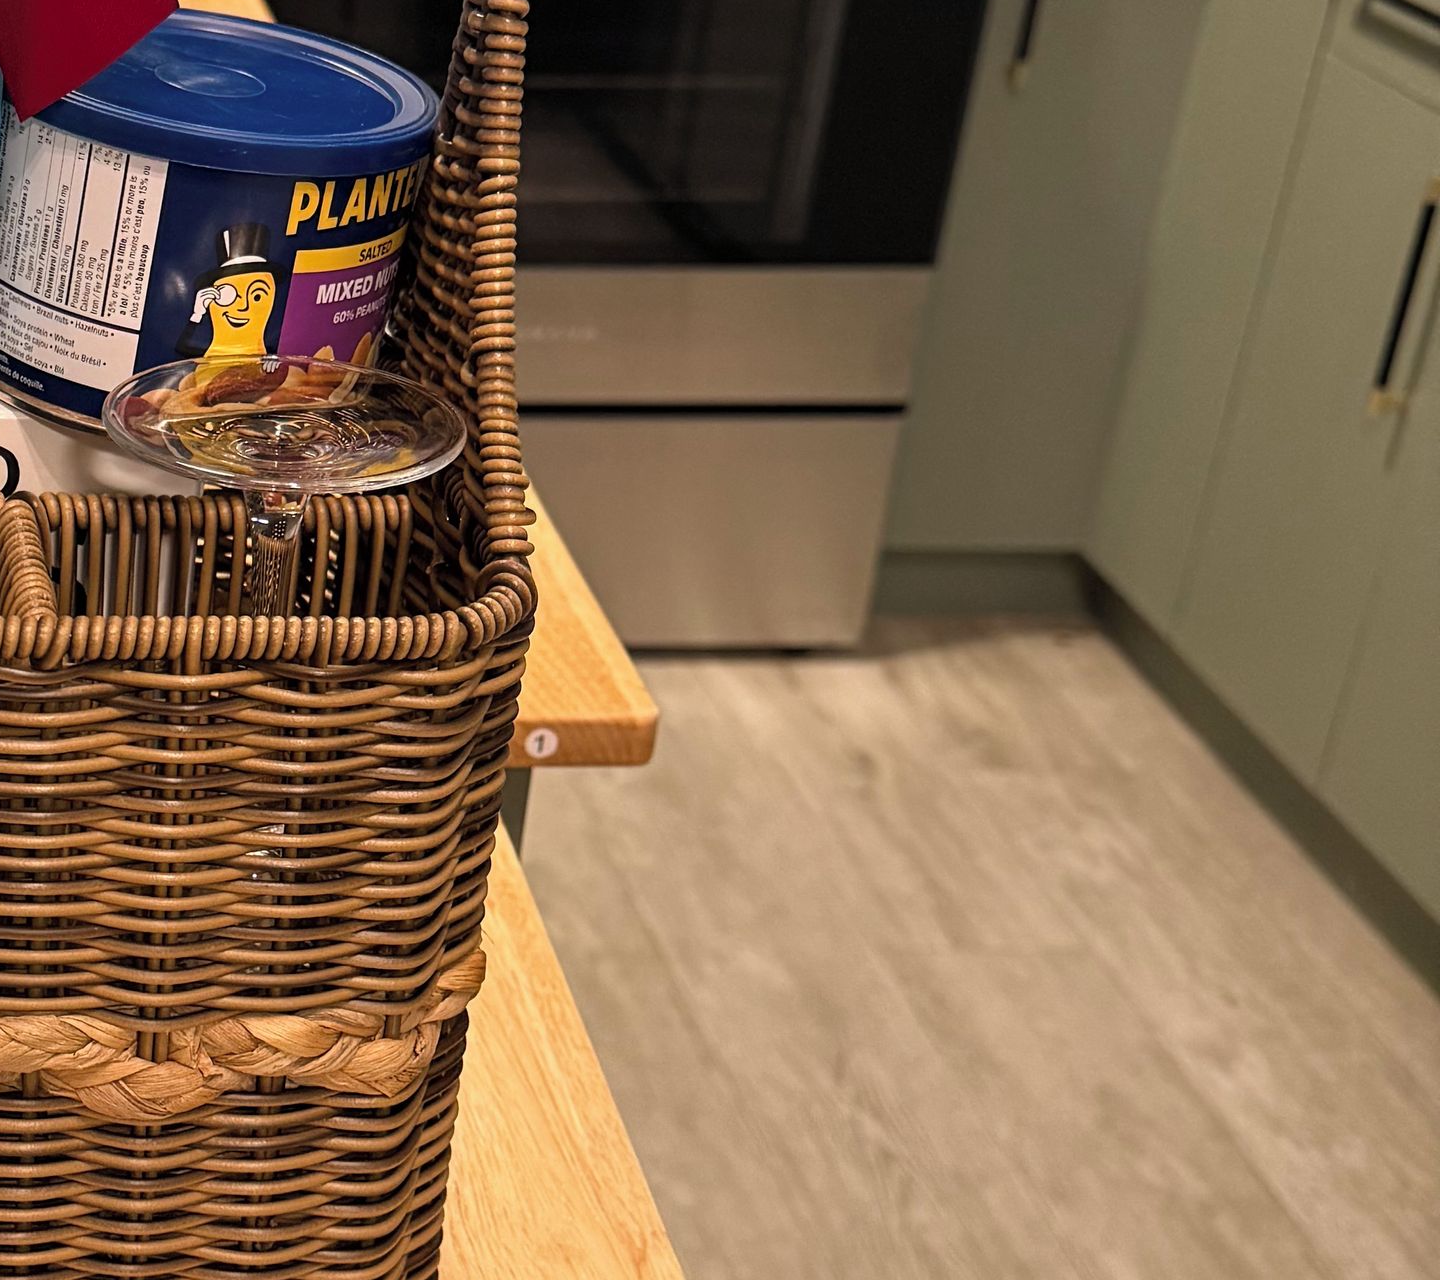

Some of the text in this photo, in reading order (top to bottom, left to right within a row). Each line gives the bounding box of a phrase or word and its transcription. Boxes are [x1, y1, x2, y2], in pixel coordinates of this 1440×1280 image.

[113, 163, 121, 171] 13
[144, 166, 151, 175] ou
[60, 185, 68, 197] mg
[139, 178, 148, 194] 15%
[127, 185, 136, 204] more
[285, 165, 418, 236] PLANTE
[125, 207, 132, 215] or
[121, 217, 130, 233] 15%
[64, 245, 72, 257] mg
[80, 240, 89, 252] mg
[130, 236, 139, 259] moins
[359, 240, 393, 262] SALTED
[77, 254, 85, 268] 350
[100, 249, 108, 261] mg
[25, 255, 34, 280] Sugars
[61, 259, 69, 273] 250
[88, 257, 97, 269] mg
[128, 261, 134, 270] ou
[85, 270, 93, 280] 50
[96, 263, 105, 280] 2.25
[34, 268, 44, 294] Protein
[112, 274, 121, 288] less
[130, 303, 139, 318] plus
[136, 244, 149, 281] beaucoup
[56, 275, 66, 303] Sodium
[71, 270, 83, 308] Potassium
[112, 290, 118, 298] or
[316, 275, 373, 304] MIXED
[80, 283, 91, 311] Calcium
[120, 299, 128, 308] lot
[91, 300, 99, 314] Iron
[37, 306, 53, 319] Brazil
[75, 321, 109, 337] Hazelnuts
[333, 309, 354, 324] 60%
[27, 324, 48, 337] protein
[54, 333, 75, 348] Wheat
[54, 345, 69, 357] Noix
[70, 352, 79, 361] du
